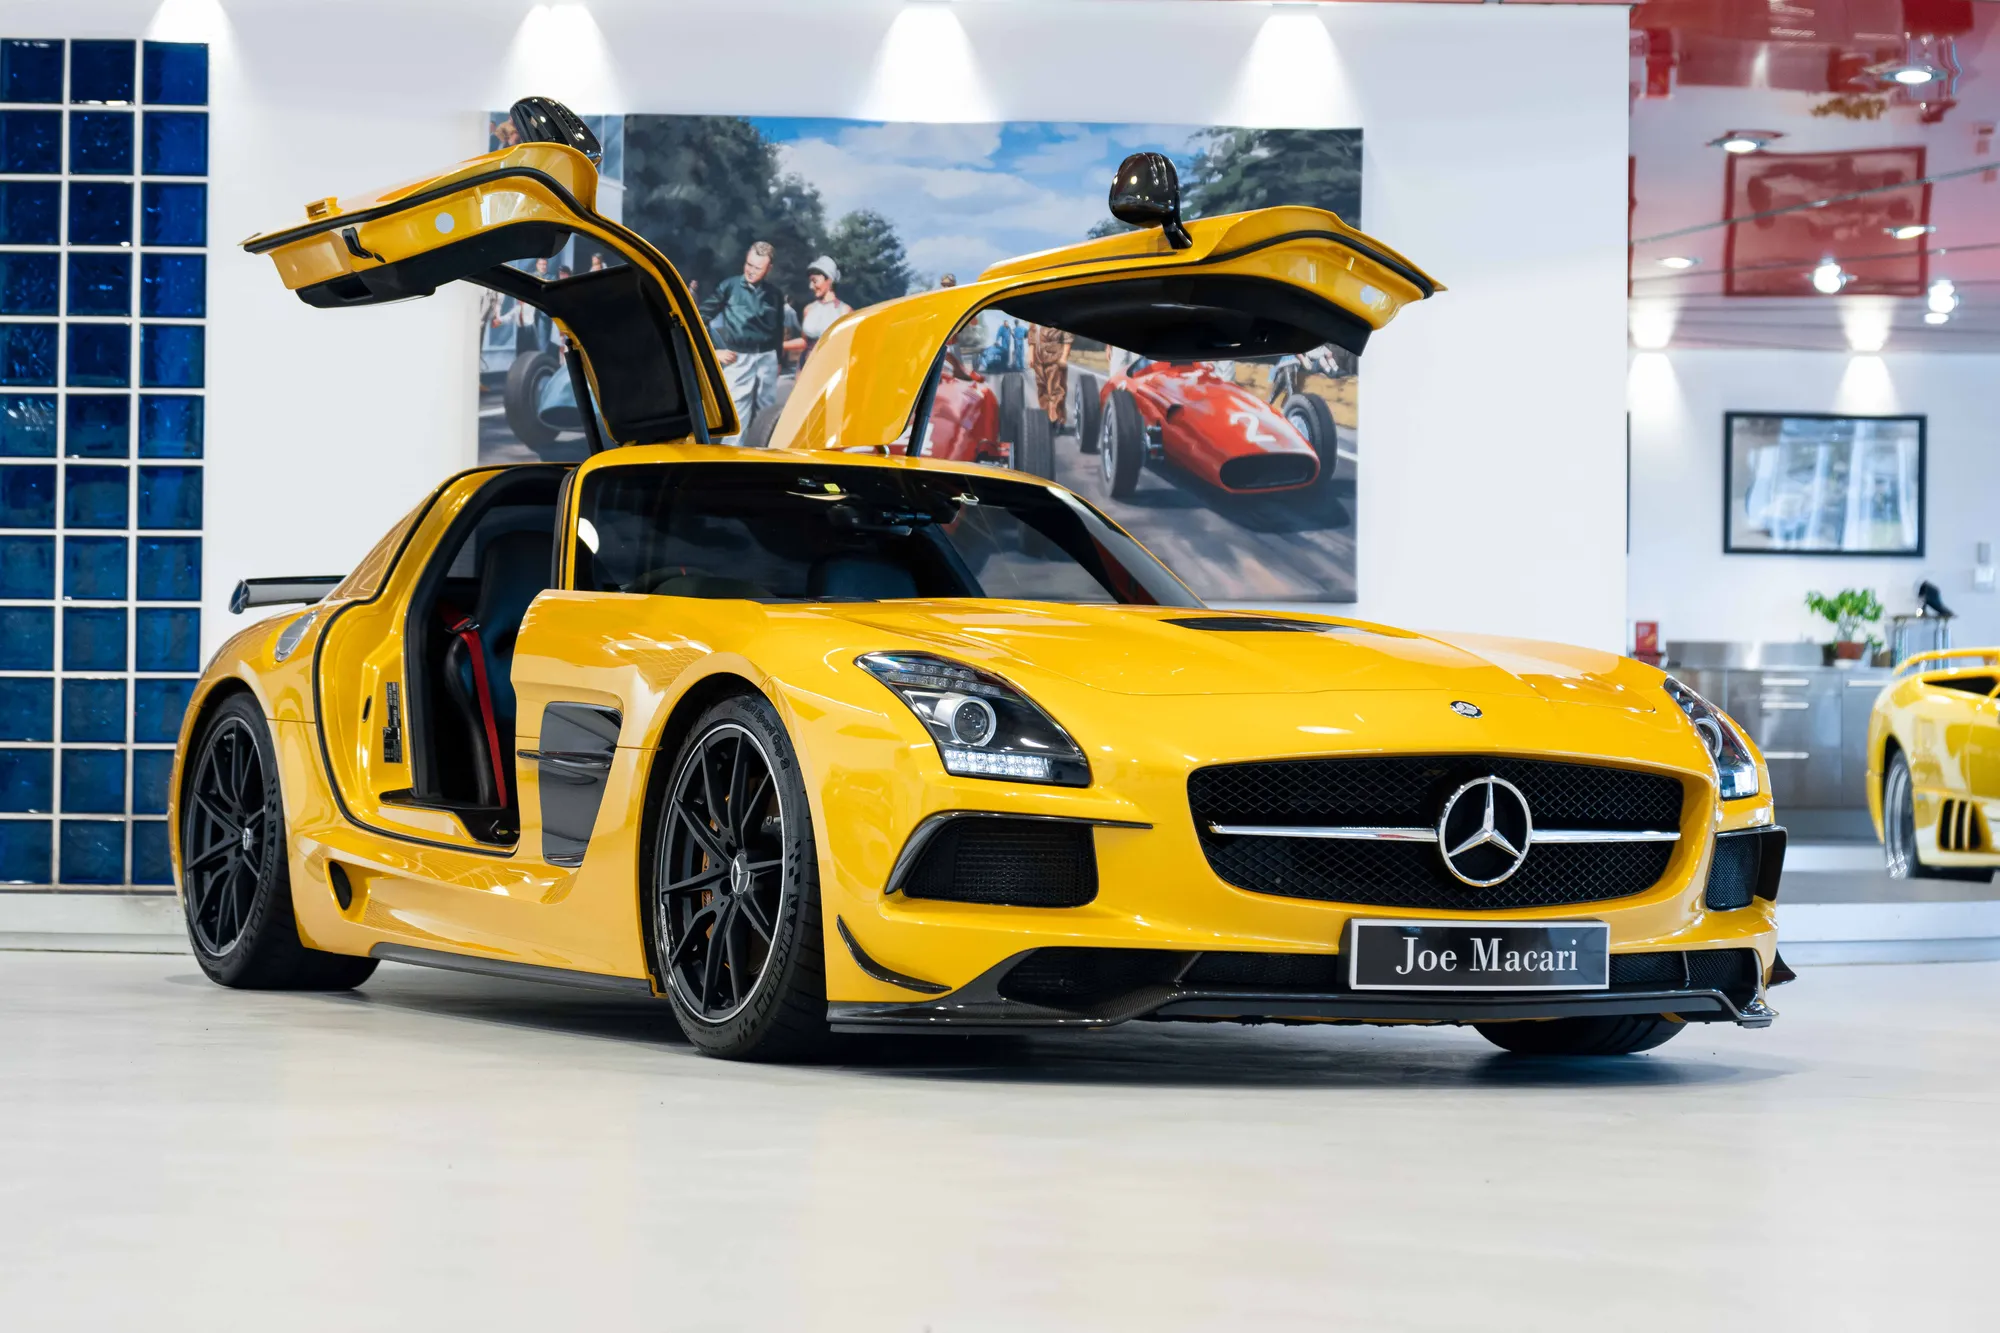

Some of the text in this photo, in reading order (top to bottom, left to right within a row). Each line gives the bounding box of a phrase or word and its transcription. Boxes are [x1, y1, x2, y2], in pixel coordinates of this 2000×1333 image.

[1229, 411, 1276, 443] 2
[754, 709, 776, 737] Sport
[772, 734, 784, 758] Cup
[780, 758, 790, 771] 2
[755, 921, 795, 1018] MICHELIN
[1395, 936, 1578, 975] Joe Macari
